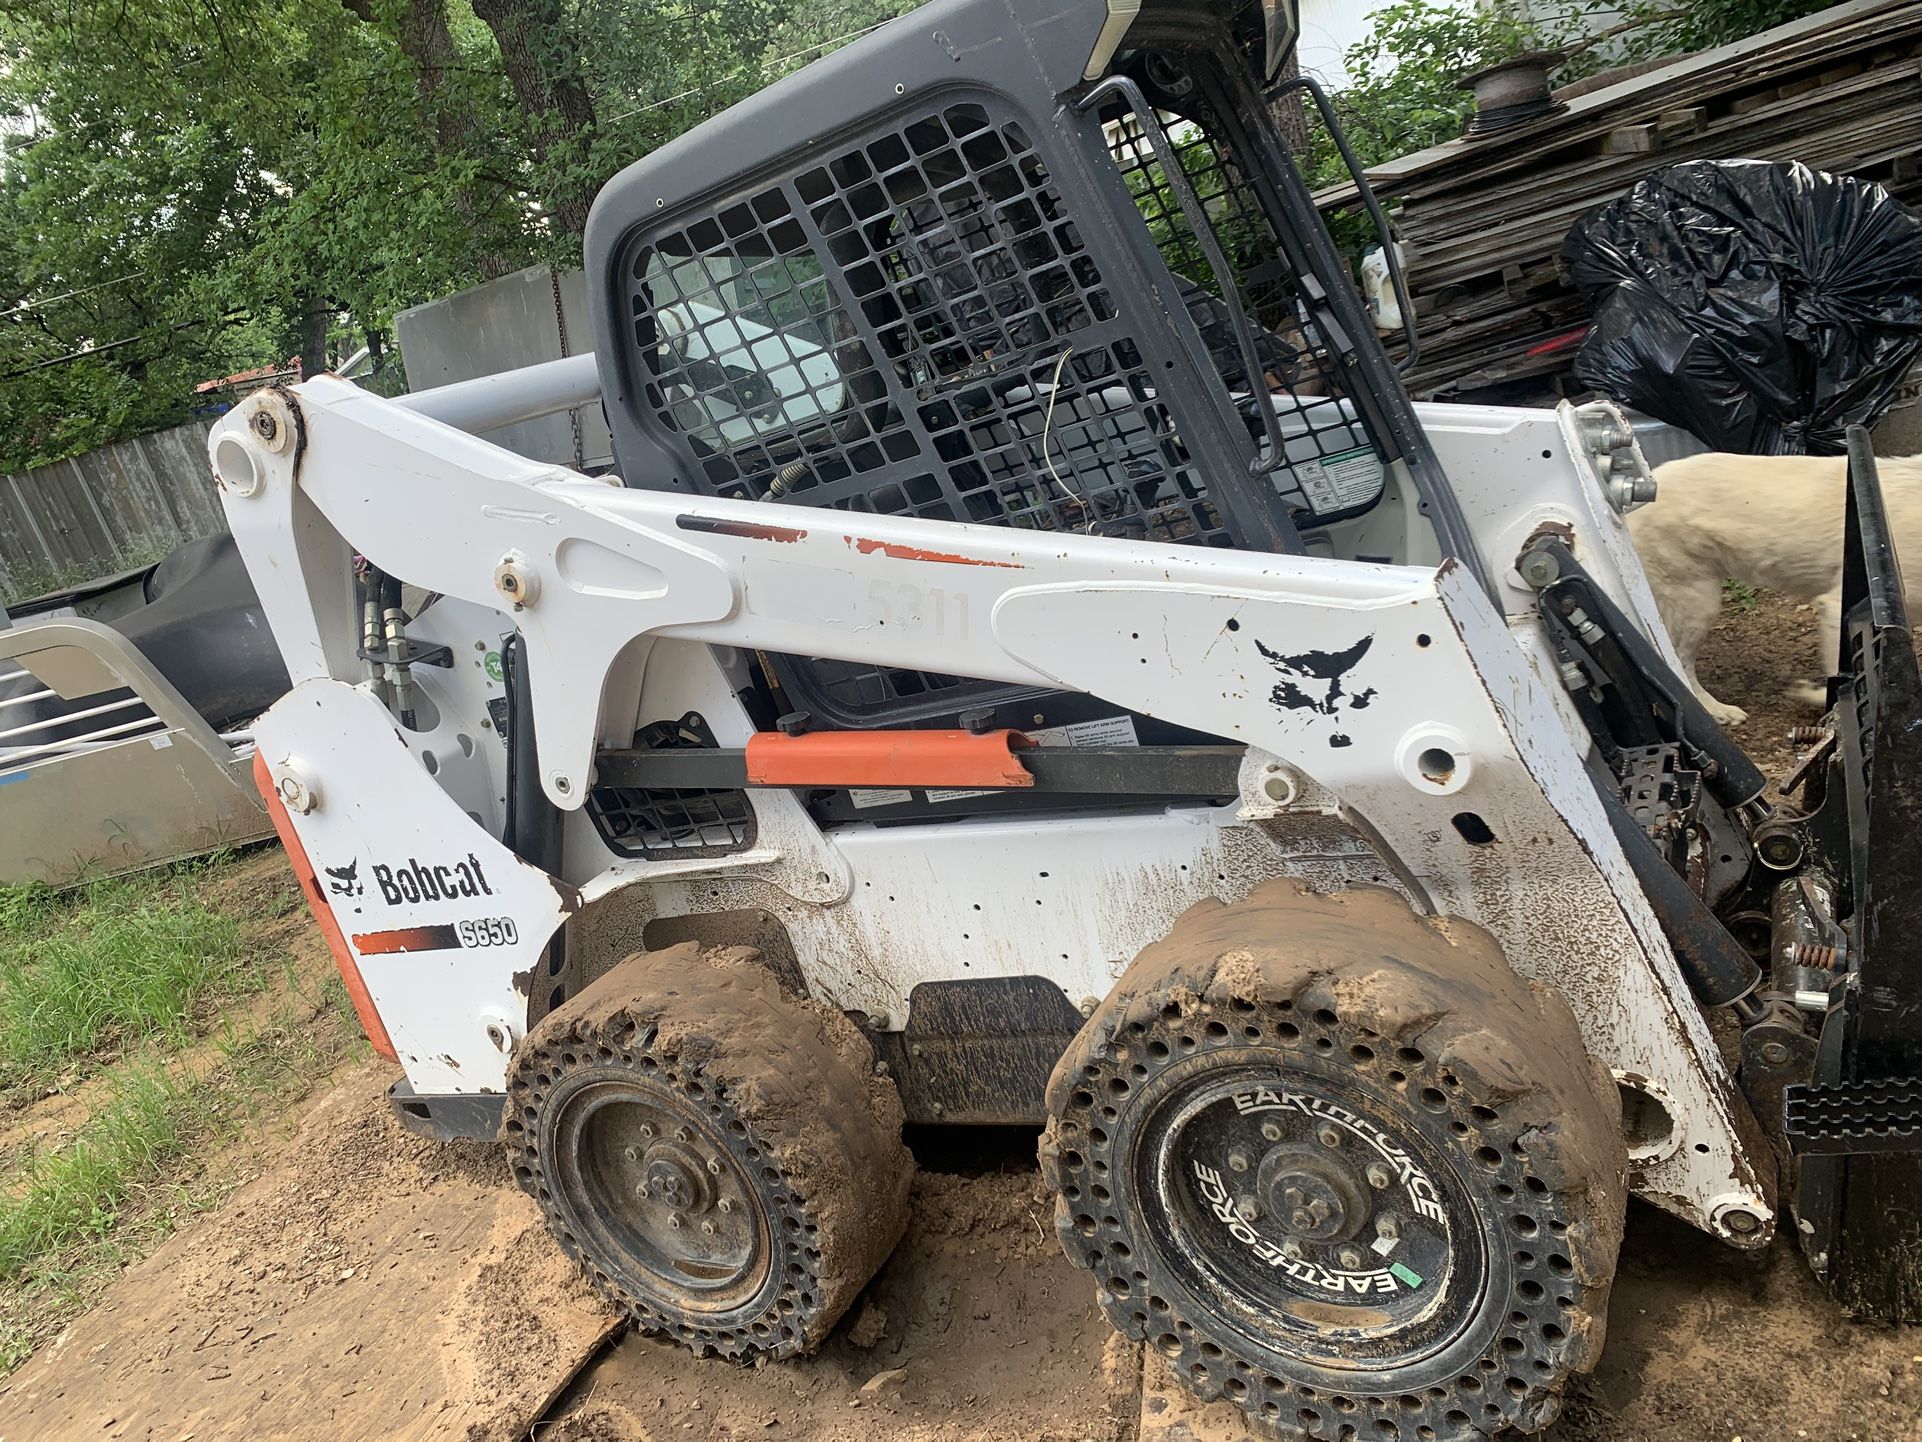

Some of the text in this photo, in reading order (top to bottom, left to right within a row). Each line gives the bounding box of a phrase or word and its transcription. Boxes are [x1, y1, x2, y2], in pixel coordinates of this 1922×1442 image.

[372, 853, 493, 906] Bobcat
[459, 916, 519, 949] S650
[1193, 1159, 1399, 1293] EARTHFORCE
